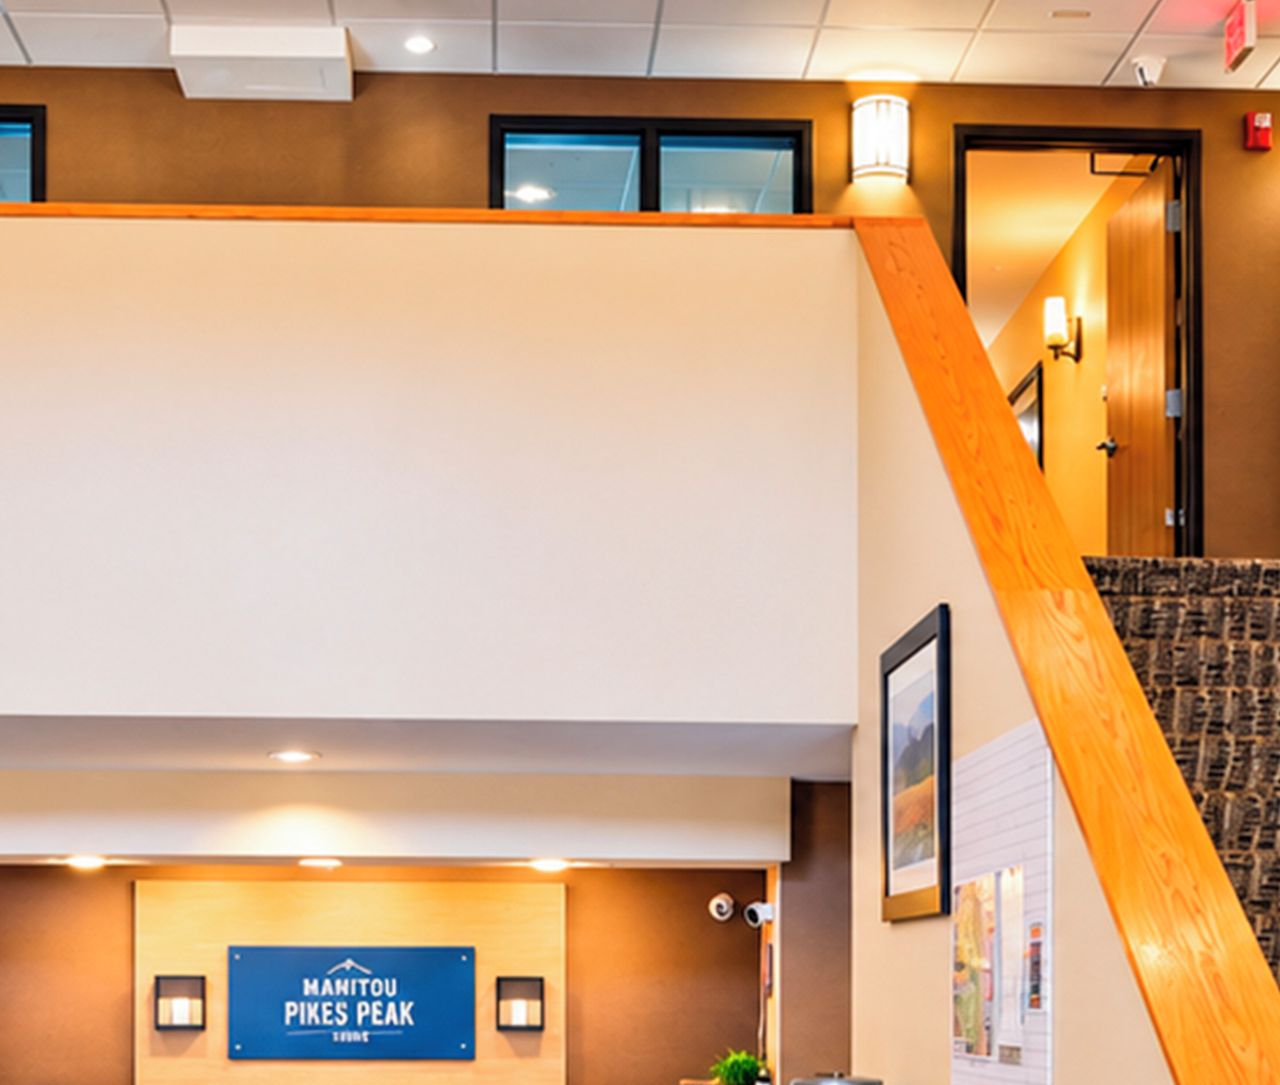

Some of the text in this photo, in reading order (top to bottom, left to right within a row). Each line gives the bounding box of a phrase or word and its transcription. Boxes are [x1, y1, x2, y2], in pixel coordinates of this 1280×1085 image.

[303, 978, 397, 997] MANITOU
[284, 1001, 414, 1026] PIKES PEAK
